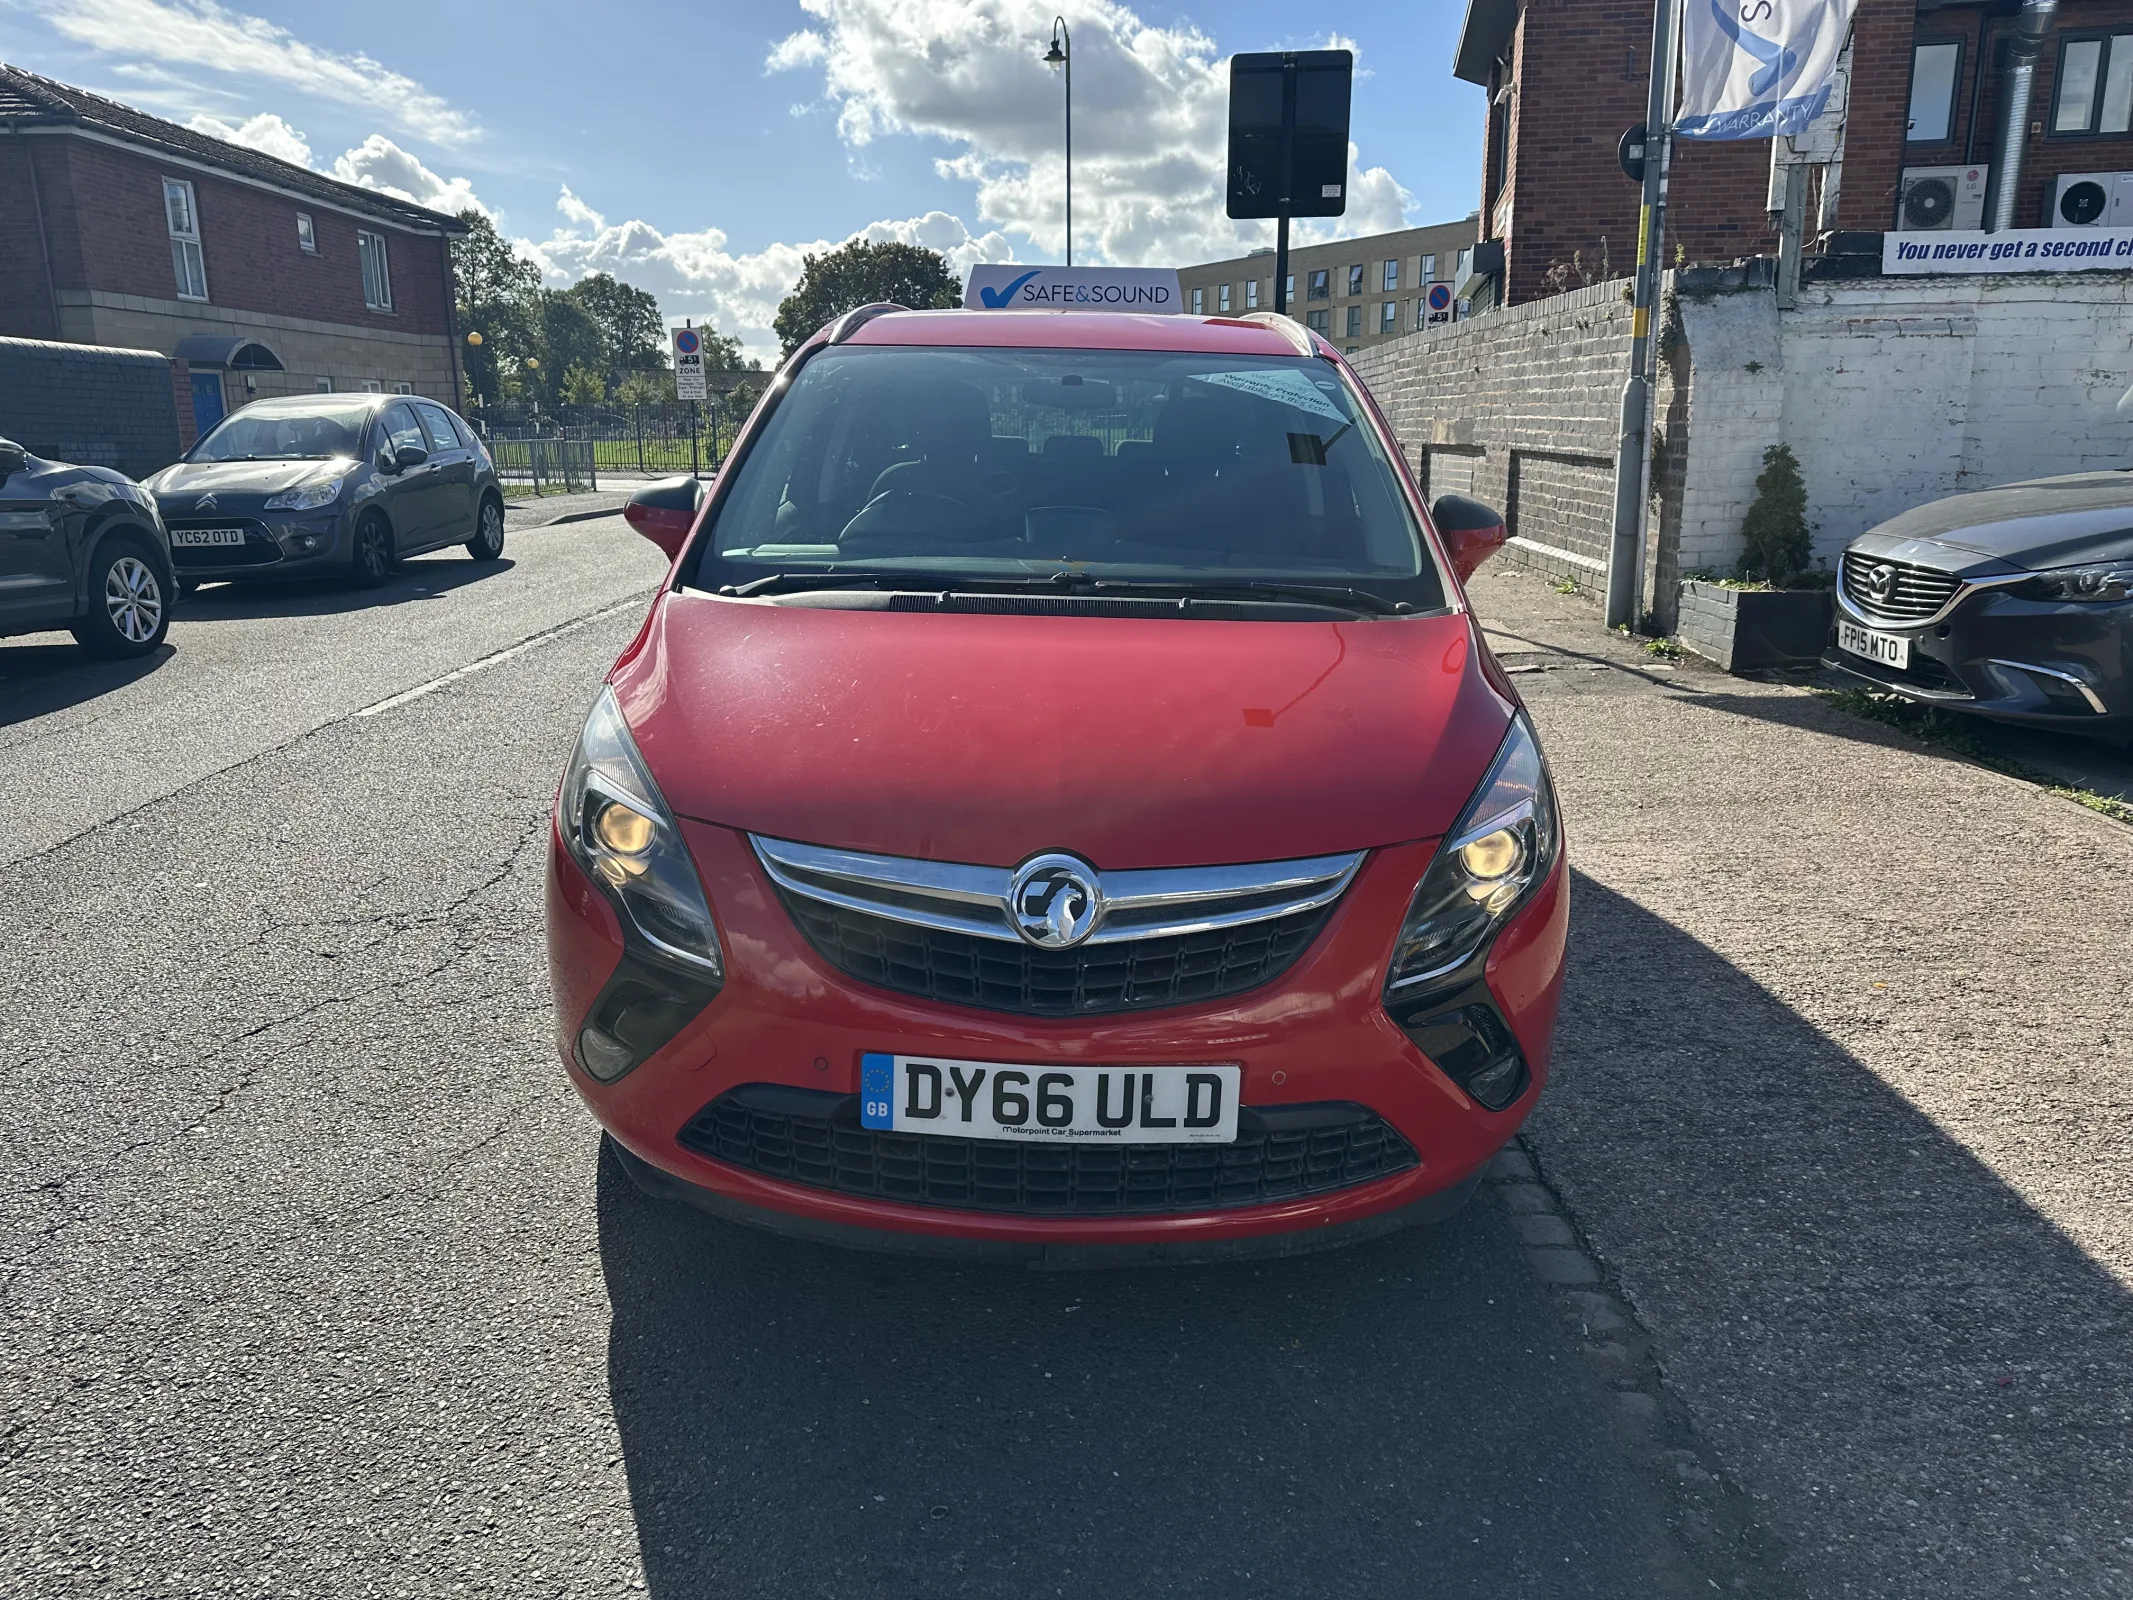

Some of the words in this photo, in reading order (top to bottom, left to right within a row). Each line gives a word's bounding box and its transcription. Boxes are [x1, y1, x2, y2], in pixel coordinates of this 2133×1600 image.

[1717, 102, 1812, 132] WARRANTY
[1897, 241, 1929, 260] You
[1932, 242, 1988, 260] never
[1989, 240, 2023, 261] get
[2025, 243, 2038, 258] a
[2041, 237, 2114, 258] second
[1023, 284, 1169, 304] SAFE&SOUND
[1218, 378, 1268, 396] Available
[1269, 392, 1284, 401] on
[1287, 395, 1305, 408] this
[1308, 403, 1327, 412] car
[1276, 387, 1330, 408] Protection
[176, 531, 210, 544] YC62
[213, 530, 239, 543] OTD
[1844, 625, 1868, 653] FP15
[1870, 634, 1898, 661] MTO
[904, 1062, 1075, 1127] DY66
[1096, 1073, 1223, 1129] ULD
[866, 1101, 888, 1117] GB
[1051, 1128, 1066, 1136] Car
[1068, 1128, 1121, 1137] Supermarket
